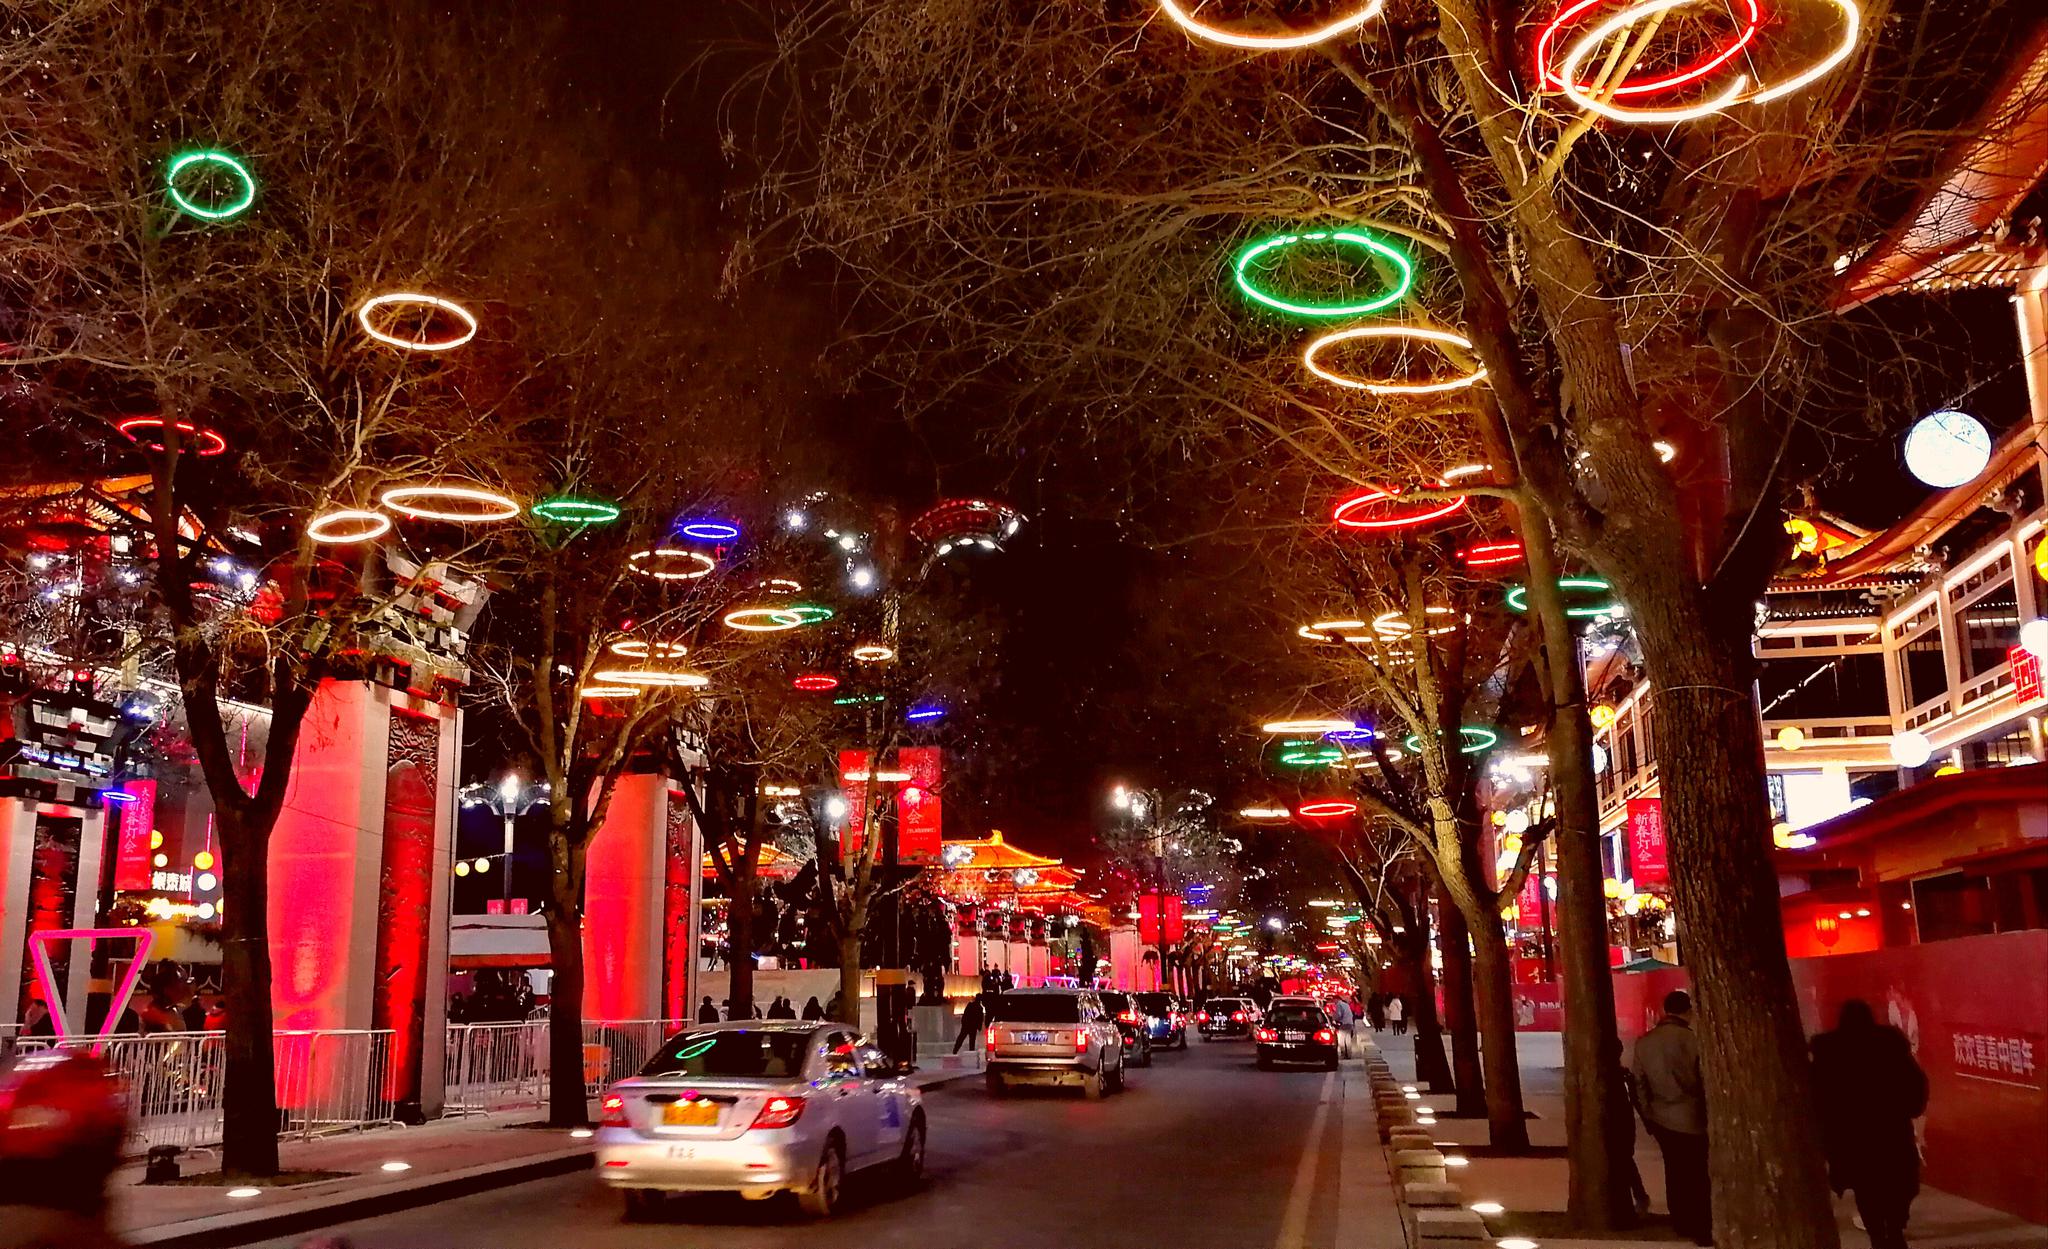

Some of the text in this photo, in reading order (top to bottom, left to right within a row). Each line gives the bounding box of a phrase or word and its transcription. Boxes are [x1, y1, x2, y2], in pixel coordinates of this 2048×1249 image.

[1634, 813, 1652, 862] 新春灯会
[1953, 1032, 2035, 1077] 欢欢喜喜中国年
